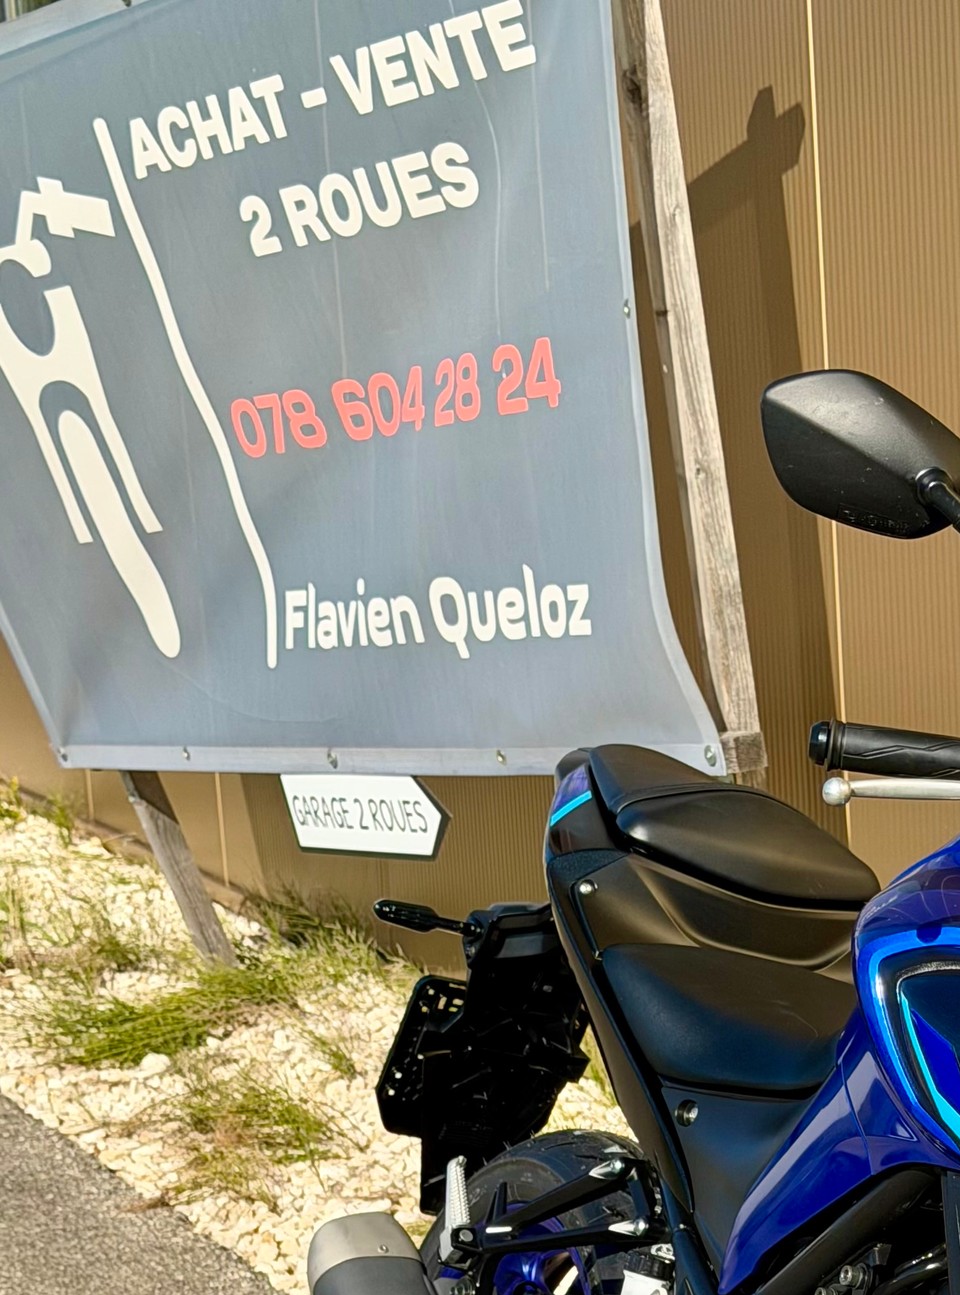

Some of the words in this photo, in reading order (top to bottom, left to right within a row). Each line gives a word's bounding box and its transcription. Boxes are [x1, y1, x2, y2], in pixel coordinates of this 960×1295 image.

[128, 74, 288, 180] ACHAT
[300, 87, 328, 109] -
[329, 0, 537, 116] VENTE
[239, 194, 283, 258] 2
[279, 141, 479, 248] ROUES
[230, 388, 328, 458] 078
[331, 365, 426, 441] 604
[433, 352, 481, 428] 28
[491, 336, 562, 416] 24
[284, 577, 426, 650] Flavien
[428, 562, 592, 660] Queloz
[292, 795, 354, 829] GARAGE
[353, 798, 370, 831] 2
[368, 798, 428, 833] ROUES
